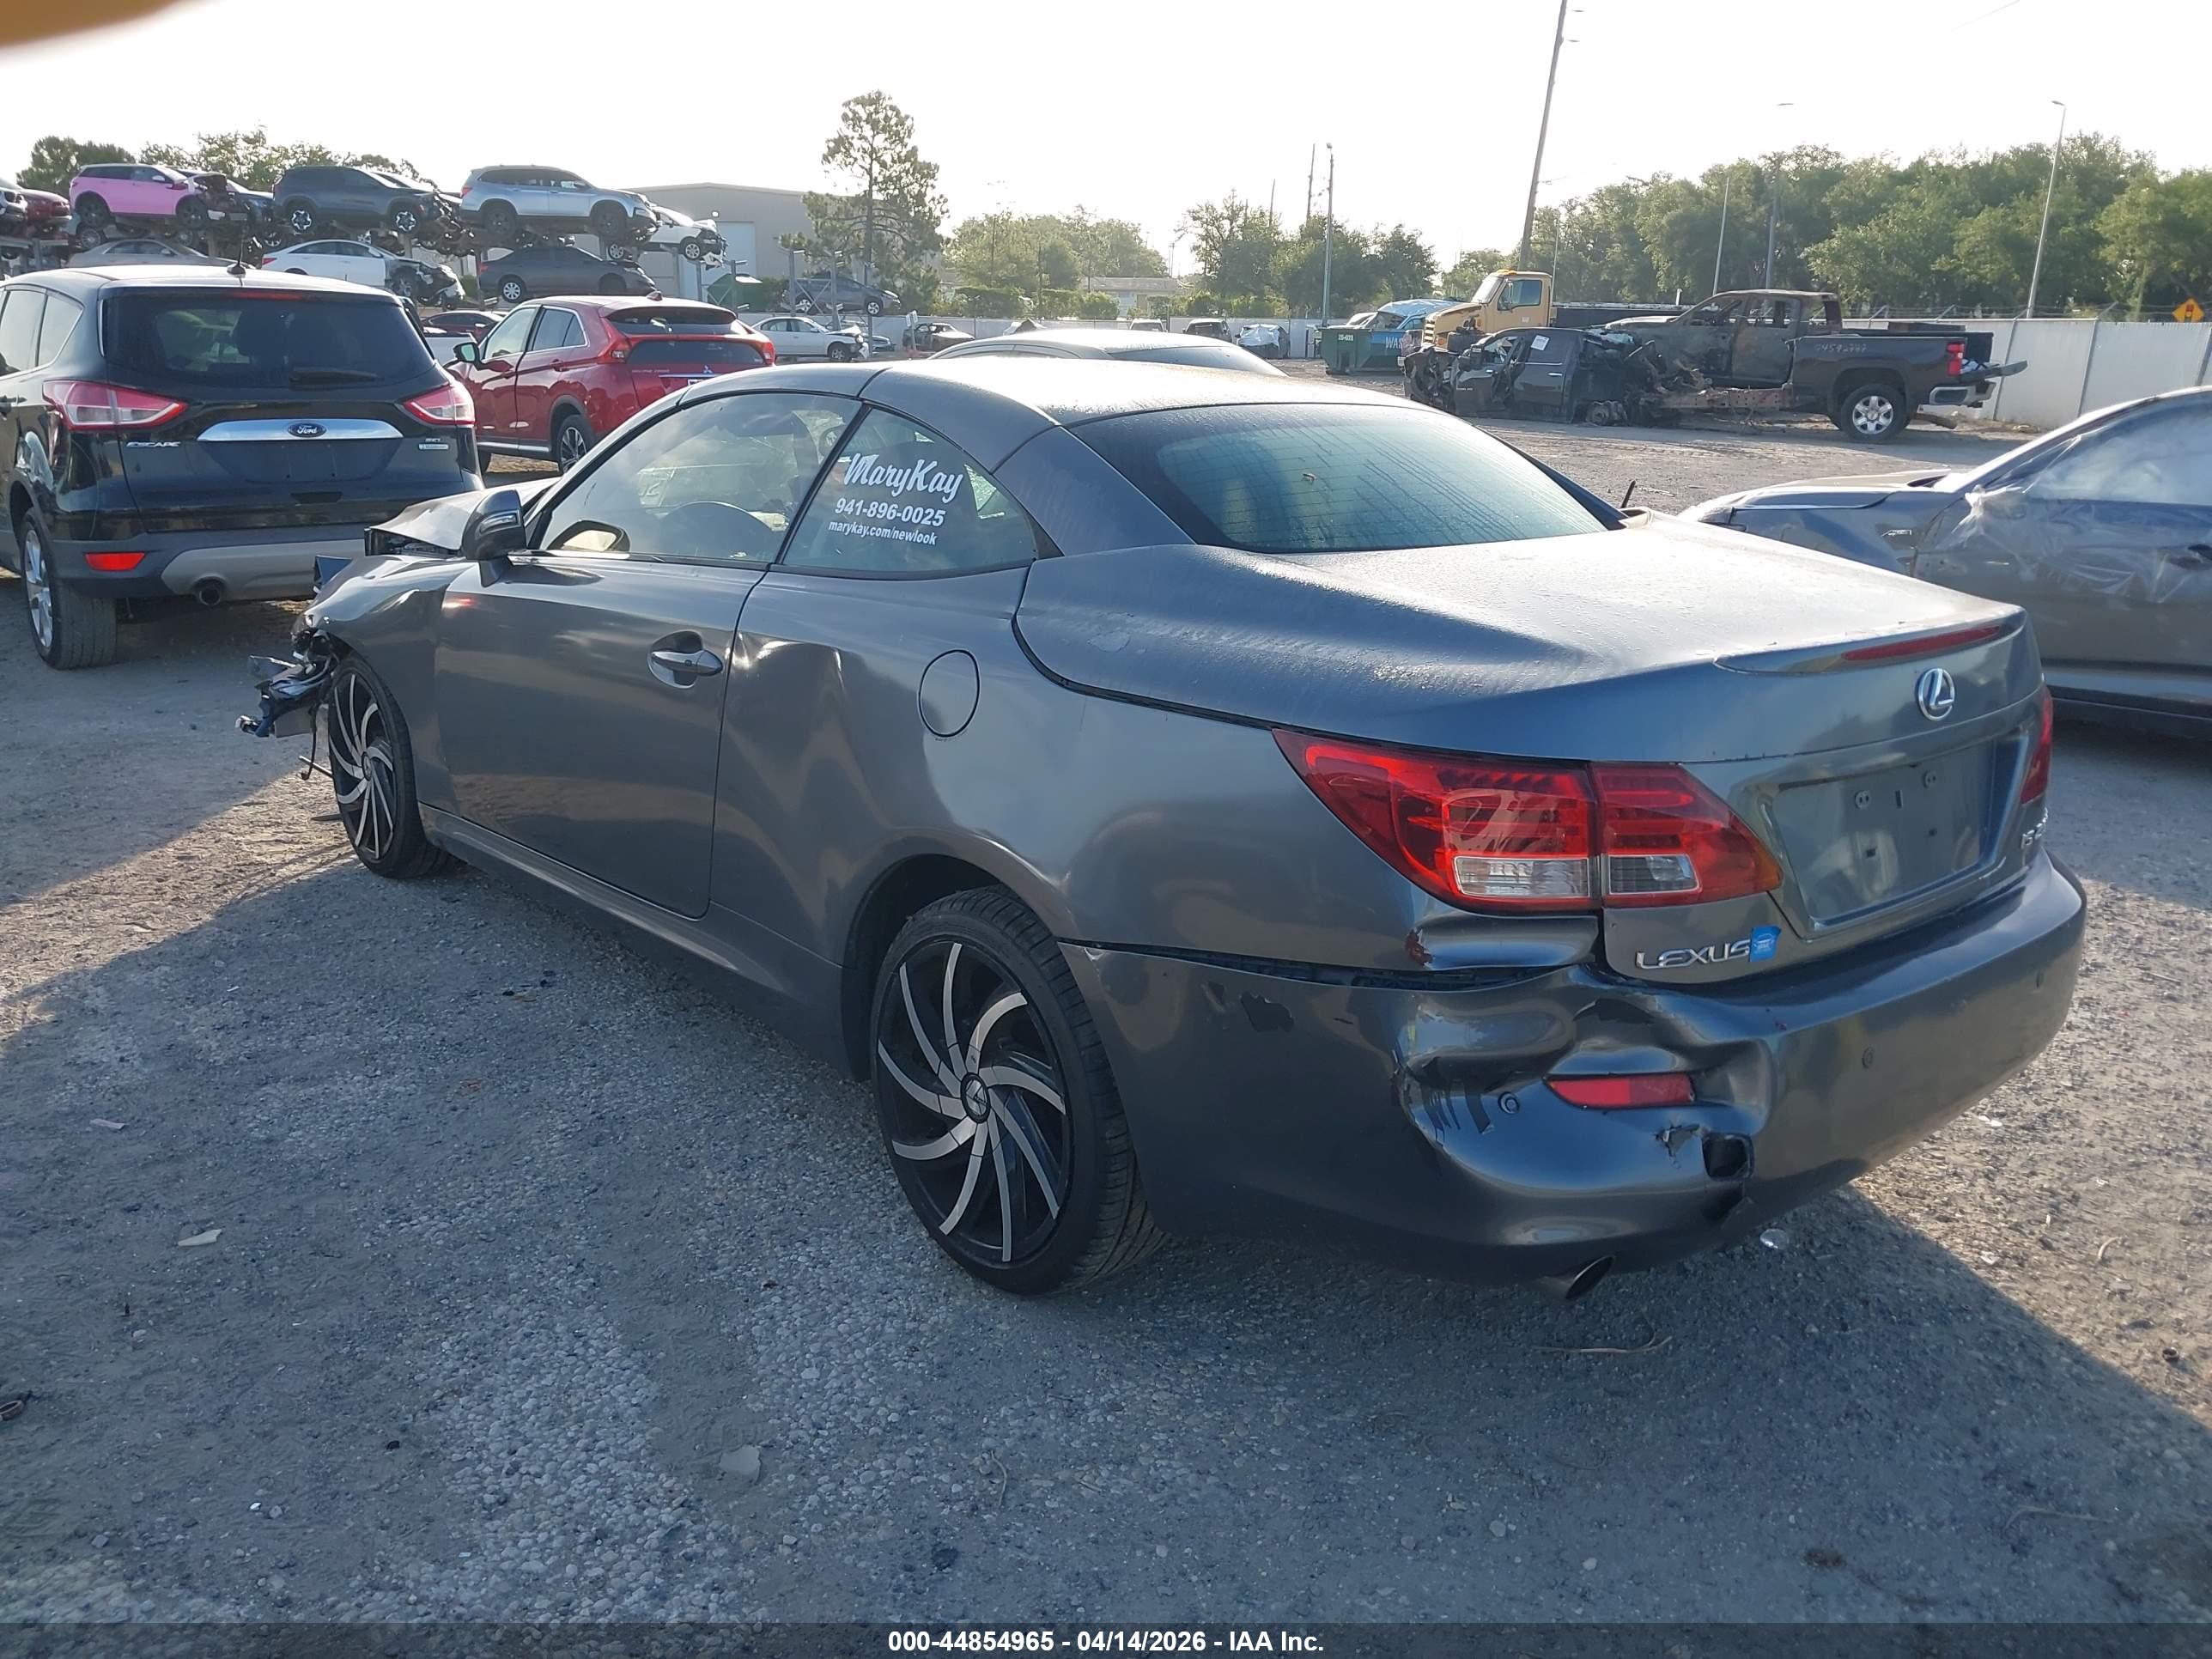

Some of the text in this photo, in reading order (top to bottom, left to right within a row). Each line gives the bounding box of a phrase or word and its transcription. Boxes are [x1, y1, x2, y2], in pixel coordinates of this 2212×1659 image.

[297, 425, 318, 434] Ford
[835, 498, 945, 526] 941-896-0025
[829, 520, 938, 545] marykay.com/newlook
[1636, 939, 1751, 969] LEXUS
